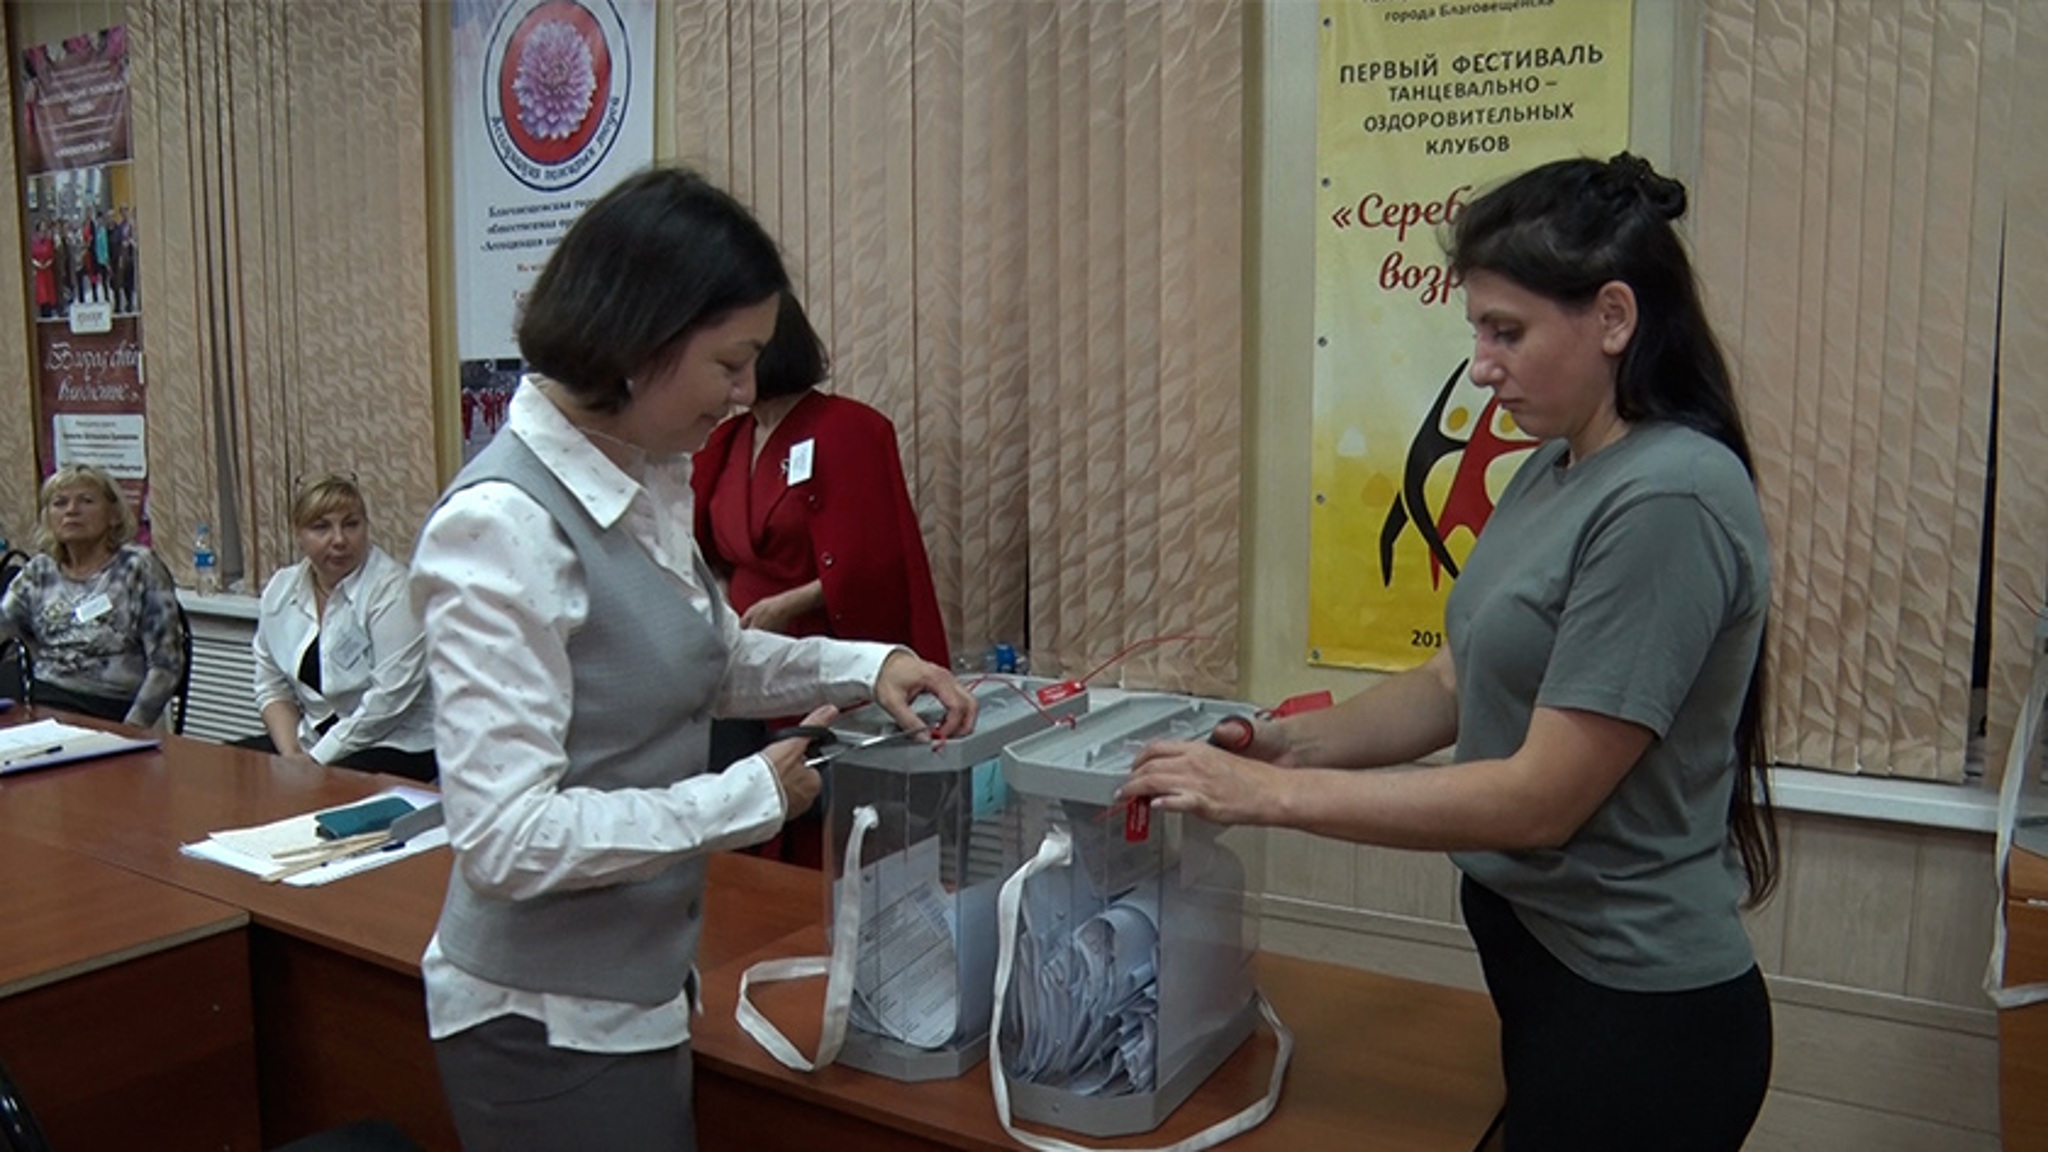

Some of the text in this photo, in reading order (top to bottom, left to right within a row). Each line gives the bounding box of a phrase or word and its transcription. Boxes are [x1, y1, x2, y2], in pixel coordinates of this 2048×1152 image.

[1384, 8, 1436, 23] города
[1340, 44, 1604, 84] ПЕРВЫЙ ФЕСТИВАЛЬ
[1388, 76, 1540, 103] ТАНЦЕВАЛЬНО
[1363, 103, 1575, 133] ОЗДОРОВИТЕЛЬНЫХ
[1425, 135, 1511, 155] КЛУБОВ
[1330, 184, 1473, 243] «Сереб
[1378, 250, 1466, 305] возр
[1410, 629, 1442, 648] 201
